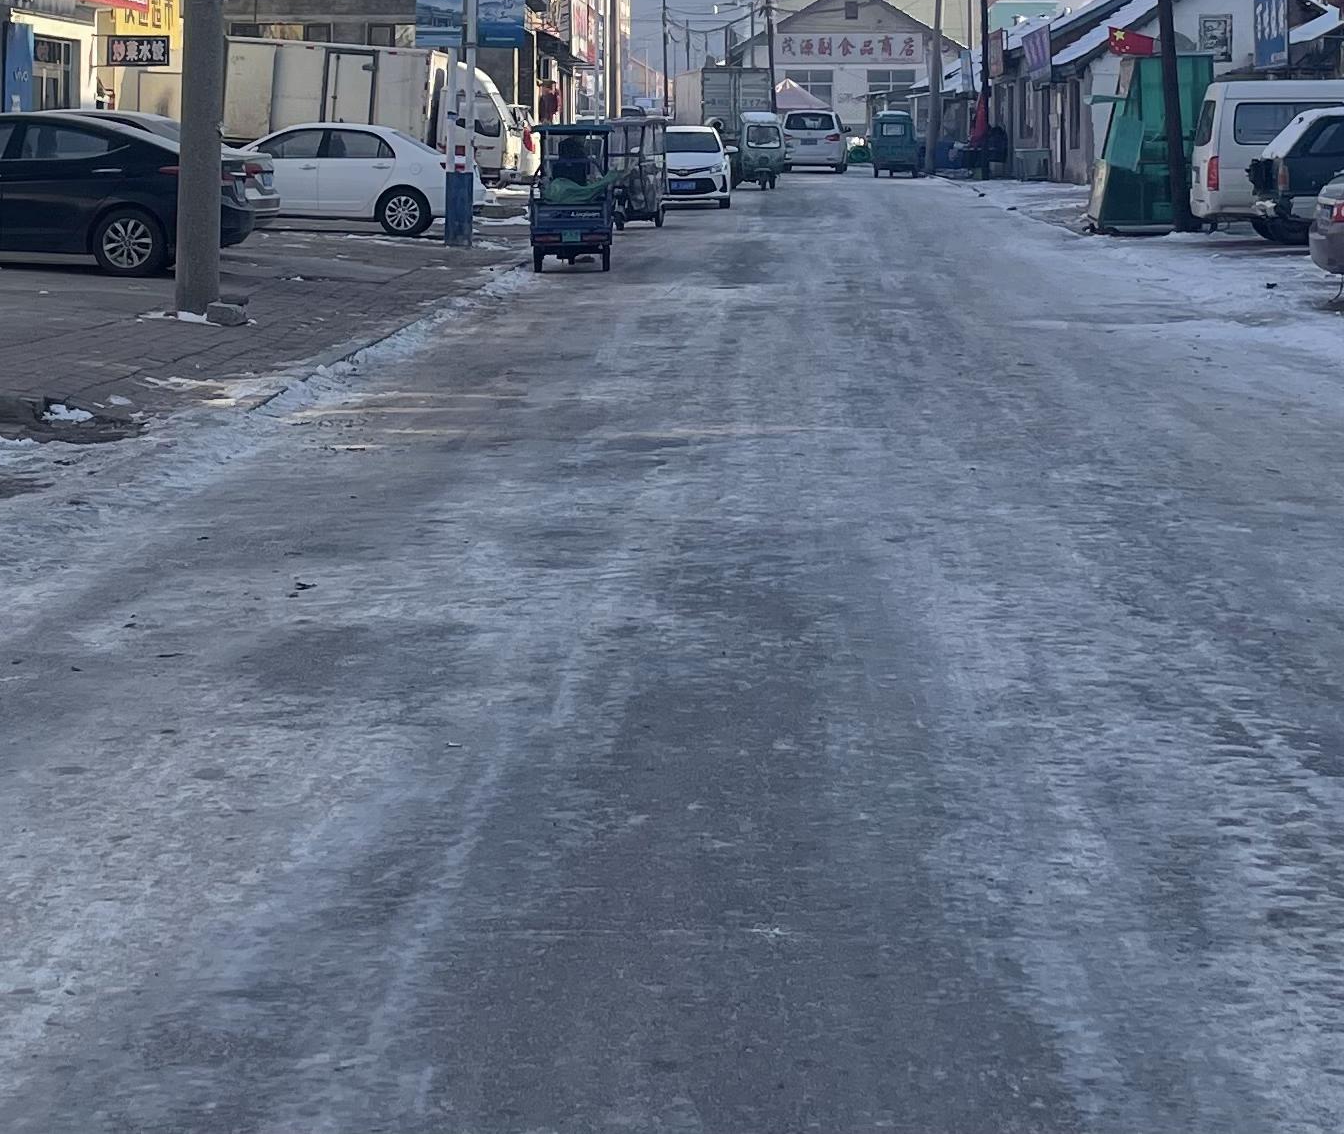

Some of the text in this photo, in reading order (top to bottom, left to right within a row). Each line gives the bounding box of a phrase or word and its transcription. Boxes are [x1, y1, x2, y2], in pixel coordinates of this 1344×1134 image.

[112, 39, 167, 62] 炒菜水饺
[781, 34, 915, 57] 茂源副食品商店
[13, 66, 29, 82] vivo
